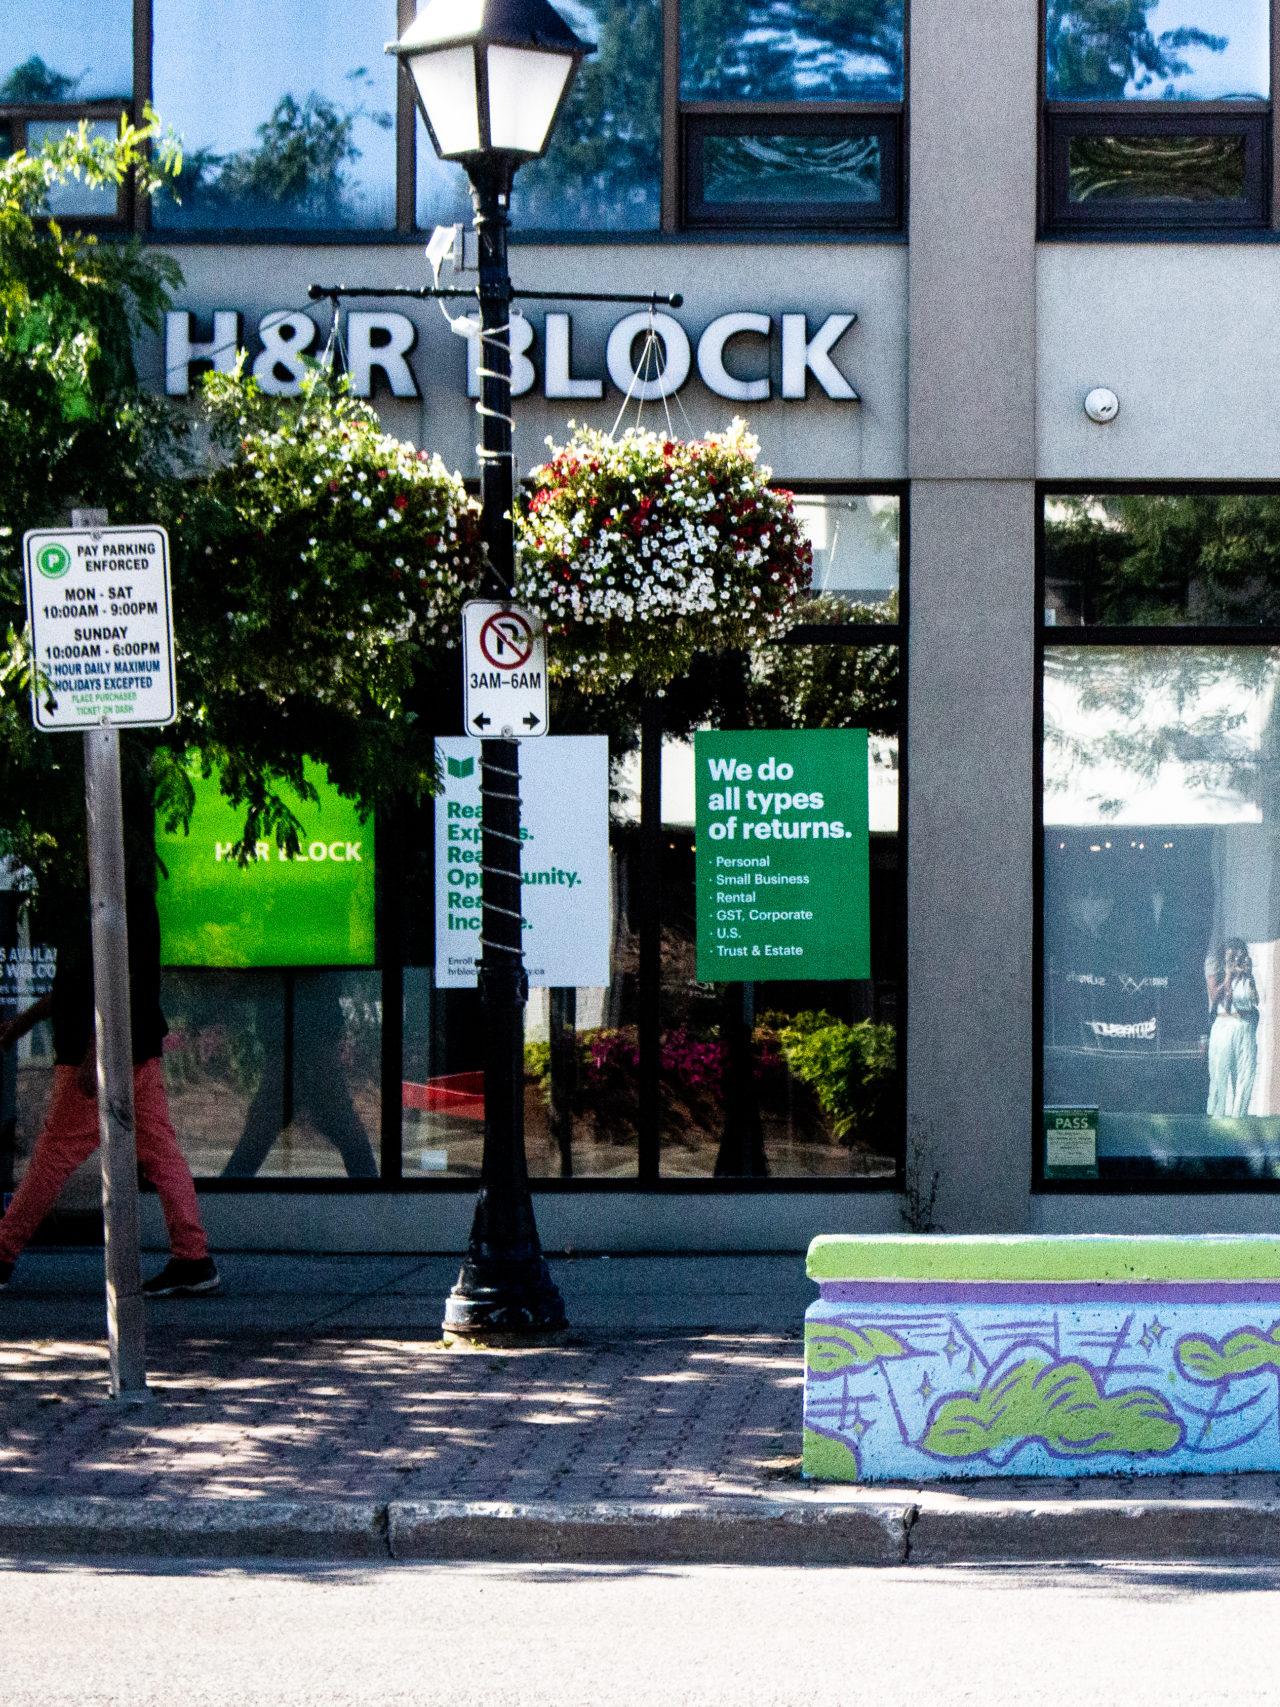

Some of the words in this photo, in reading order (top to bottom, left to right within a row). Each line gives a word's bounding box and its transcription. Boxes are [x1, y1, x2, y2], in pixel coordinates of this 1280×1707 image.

[166, 311, 418, 397] H&R
[467, 311, 858, 400] BLOCK
[77, 545, 98, 557] PAY
[102, 543, 156, 556] PARKING
[85, 559, 149, 572] ENFORCED
[64, 588, 96, 602] MON
[108, 586, 133, 600] SAT
[43, 604, 99, 619] 10:00AM
[110, 602, 158, 616] 9:00PM
[74, 626, 129, 642] SUNDAY
[45, 645, 101, 660] 10:00AM
[113, 642, 160, 657] 6:00PM
[55, 662, 82, 676] HOUR
[85, 662, 111, 675] DAILY
[114, 660, 161, 674] MAXIMUM
[55, 679, 102, 692] HOLIDAYS
[104, 676, 153, 690] EXCEPTED
[95, 692, 137, 702] PURCHASED
[708, 758, 752, 781] We
[758, 757, 794, 781] do
[708, 786, 740, 810] all
[746, 789, 824, 815] types
[447, 801, 482, 819] Rea
[447, 823, 534, 844] Exps.
[708, 816, 737, 840] of
[743, 819, 853, 840] returns.
[214, 842, 269, 862] HR
[447, 846, 482, 863] Rea
[716, 855, 770, 867] Personal
[447, 867, 582, 889] Opunity.
[716, 874, 751, 886] Small
[755, 873, 810, 885] Business
[447, 891, 482, 909] Rea
[716, 891, 756, 904] Rental
[716, 910, 746, 922] GST,
[749, 909, 813, 923] Corporate
[716, 927, 742, 939] U.S.
[9, 947, 58, 962] AVAILA
[716, 945, 748, 957] Trust
[751, 945, 761, 956] &
[764, 944, 803, 957] Estate
[448, 956, 473, 966] Enroll
[1055, 1117, 1089, 1129] PASS
